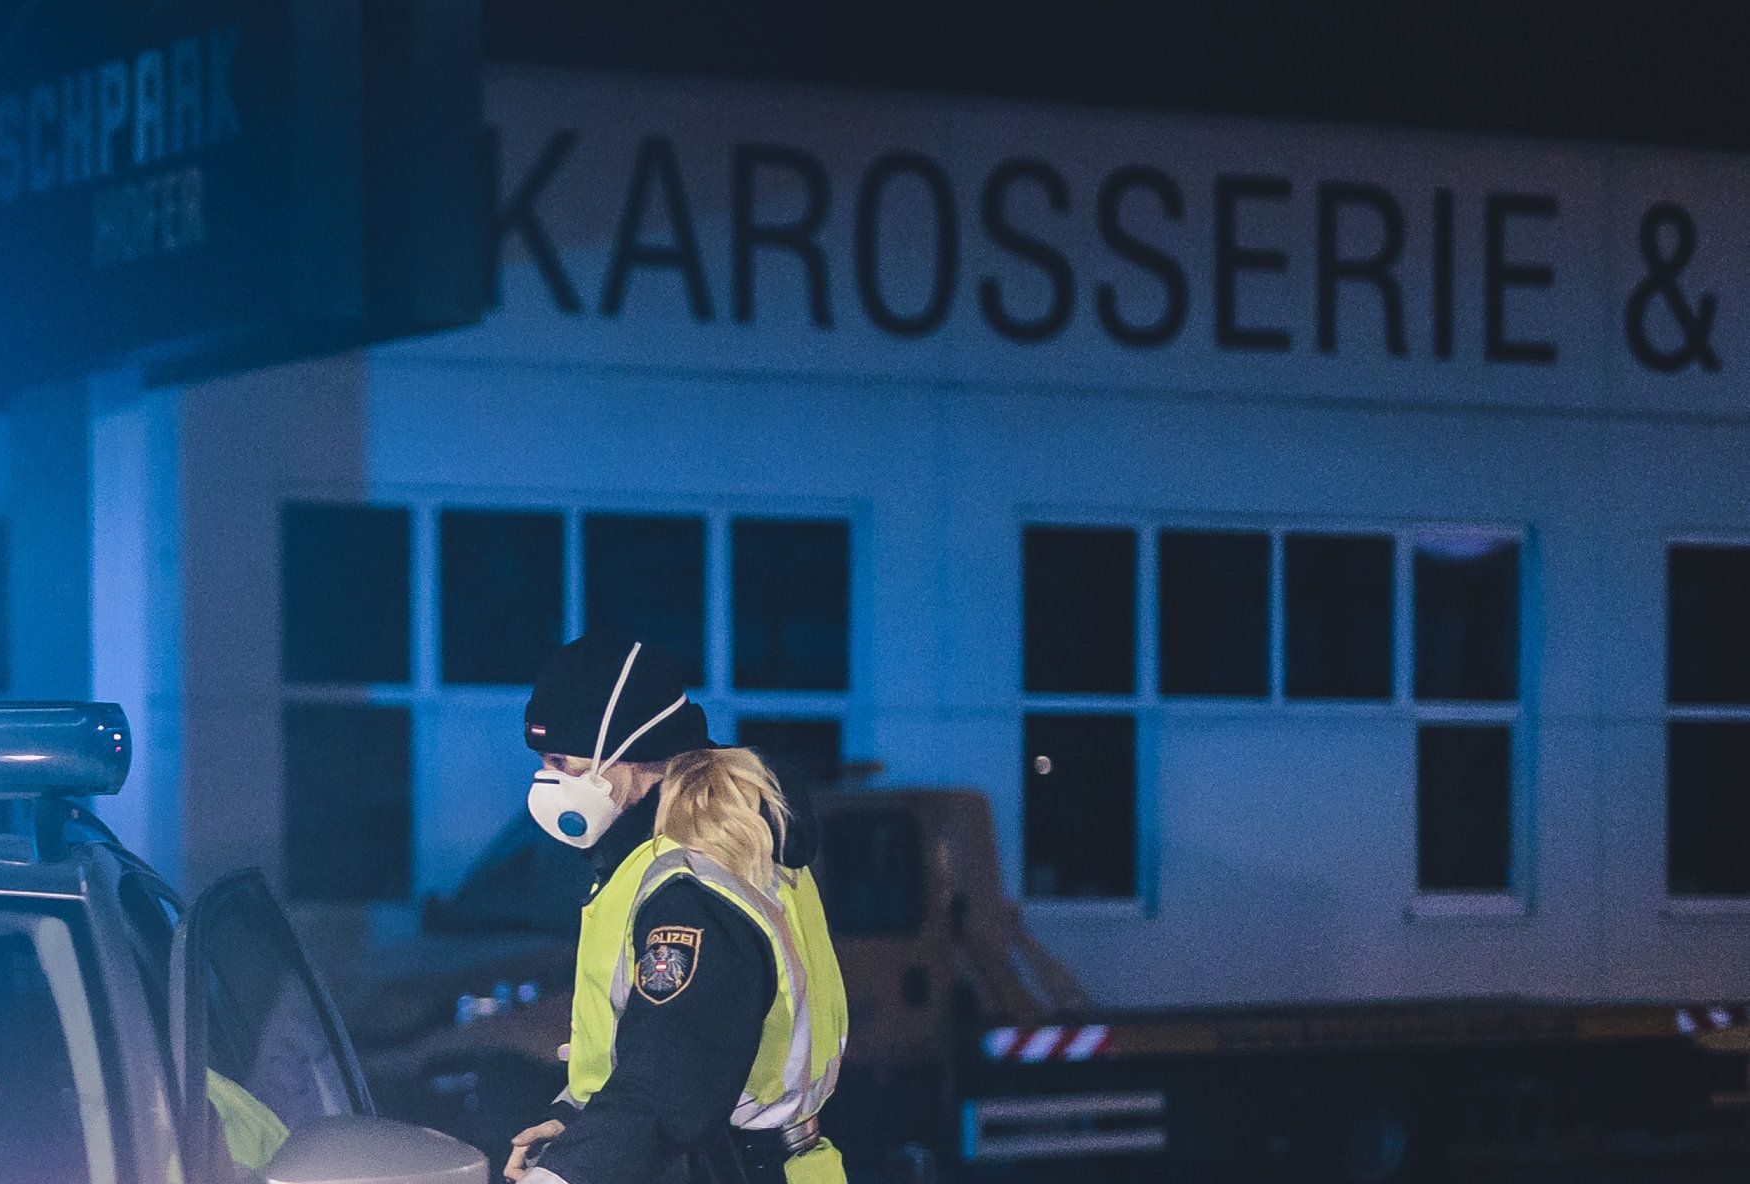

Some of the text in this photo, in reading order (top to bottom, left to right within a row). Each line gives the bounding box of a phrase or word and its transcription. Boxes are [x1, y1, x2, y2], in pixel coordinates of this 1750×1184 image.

[92, 164, 207, 270] HOFER
[484, 126, 1723, 375] KAROSSERIE &
